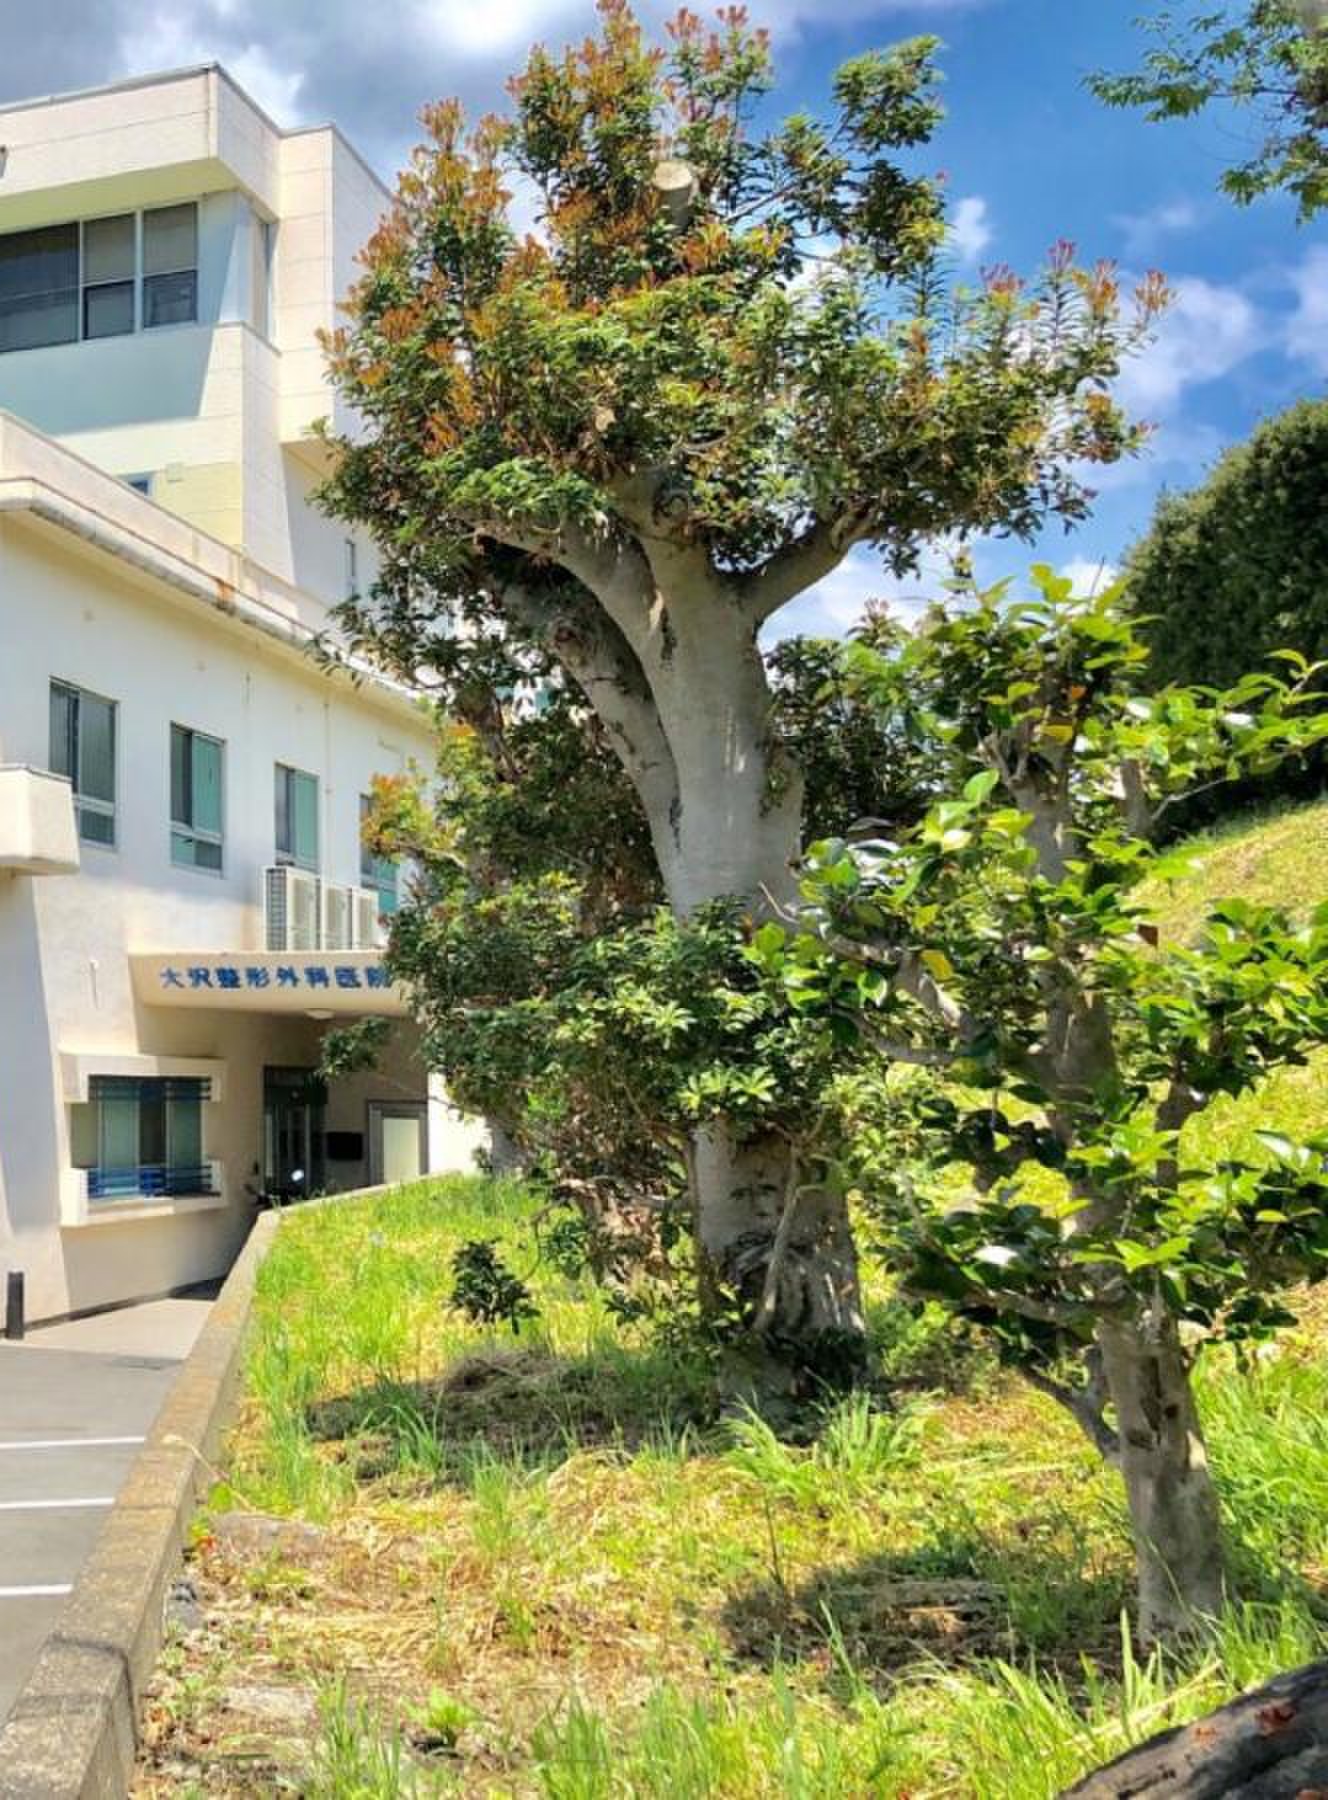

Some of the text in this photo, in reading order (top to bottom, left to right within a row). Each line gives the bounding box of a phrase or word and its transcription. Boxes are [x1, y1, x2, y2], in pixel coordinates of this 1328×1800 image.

[160, 965, 392, 989] 大沢整形外科医院
